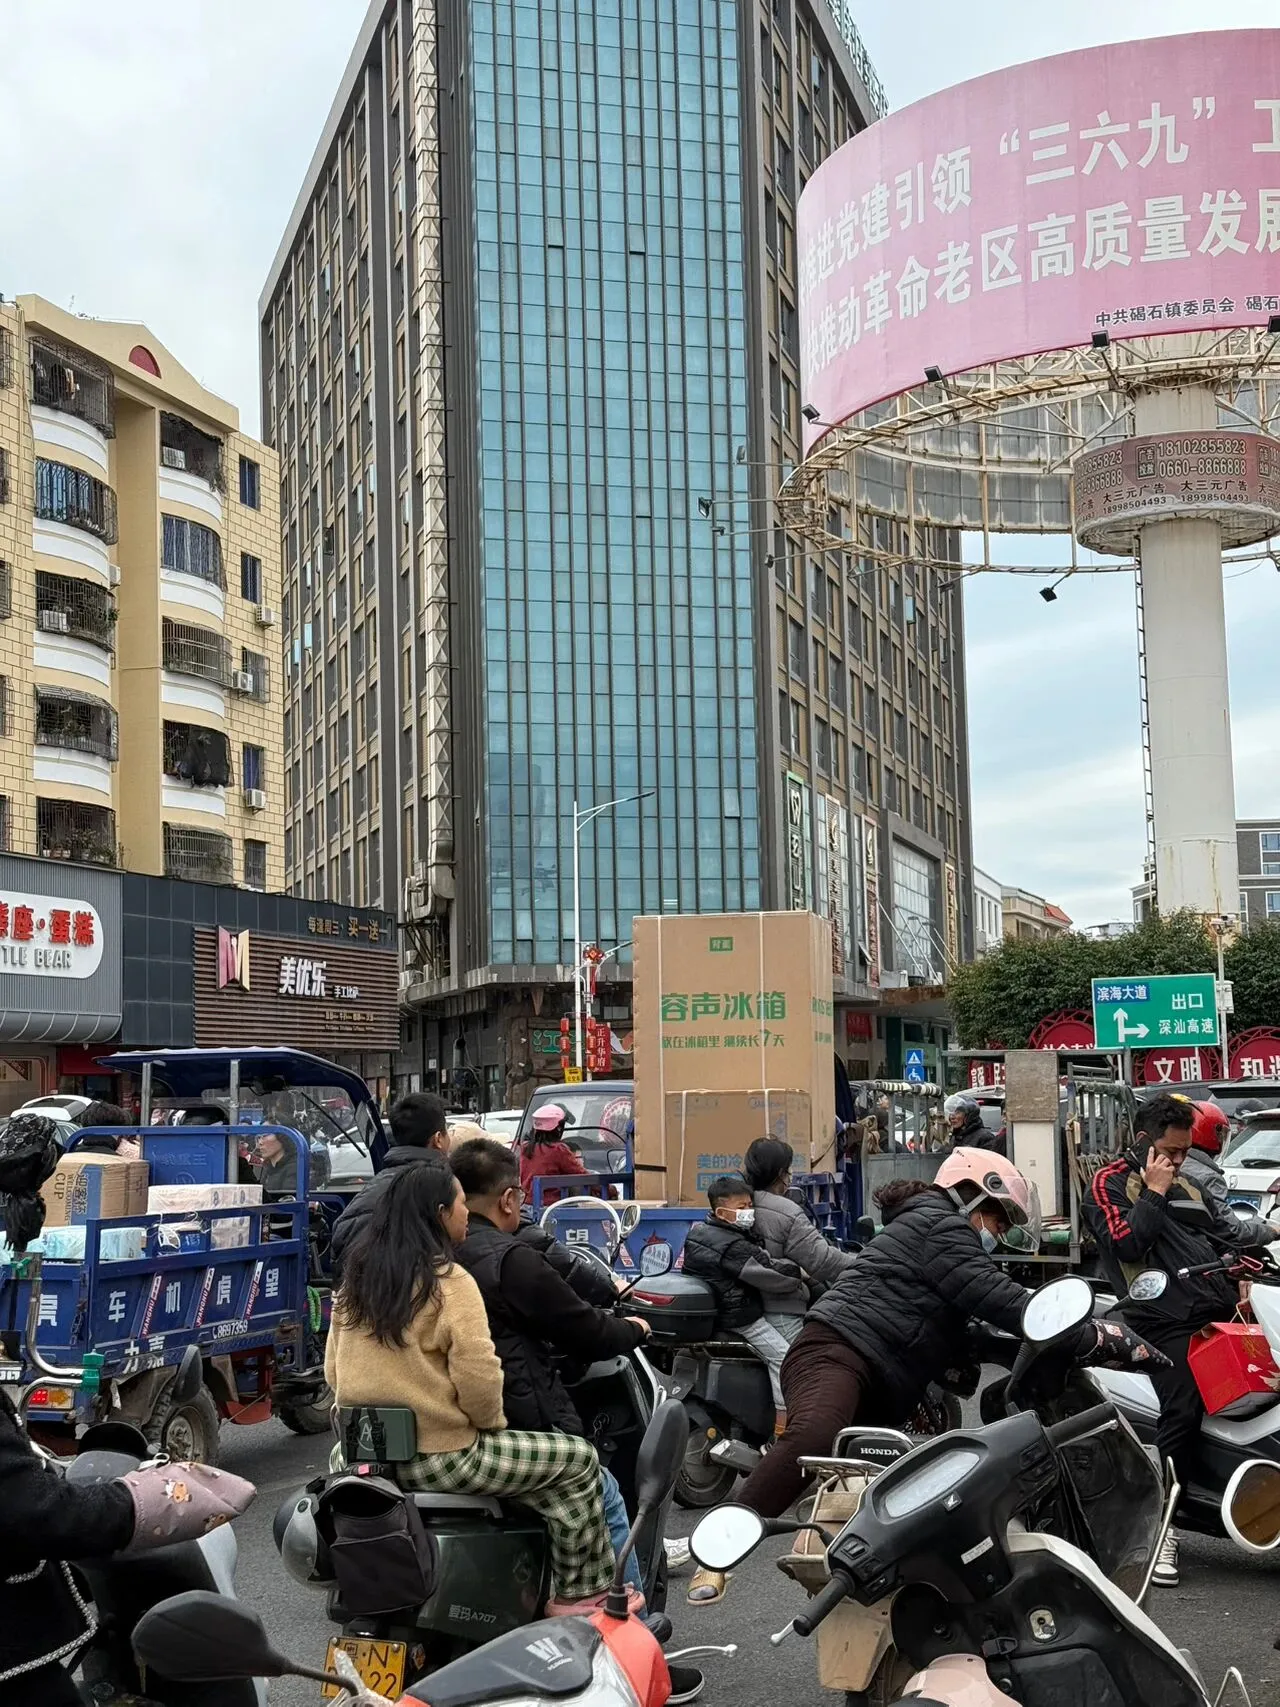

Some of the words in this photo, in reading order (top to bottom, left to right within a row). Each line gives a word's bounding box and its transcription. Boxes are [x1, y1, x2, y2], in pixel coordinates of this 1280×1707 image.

[801, 146, 971, 308] 推进党建引领
[1096, 297, 1235, 327] 中共碣石镇委员会
[1159, 438, 1246, 457] 18102855823
[1160, 459, 1247, 477] 0660-8866888
[1103, 483, 1165, 504] 大三元广告
[1180, 480, 1248, 491] 大三元广告
[1181, 493, 1249, 502] 18998504493
[34, 948, 72, 968] BEAR
[279, 956, 327, 997] 美优乐
[1097, 984, 1148, 1001] 滨海大道
[1172, 993, 1204, 1010] 出口
[661, 991, 786, 1021] 容声冰箱
[1158, 1018, 1215, 1035] 深汕高速
[1153, 1057, 1203, 1083] 文明
[54, 1172, 66, 1200] CUP
[860, 1447, 901, 1456] HONDA
